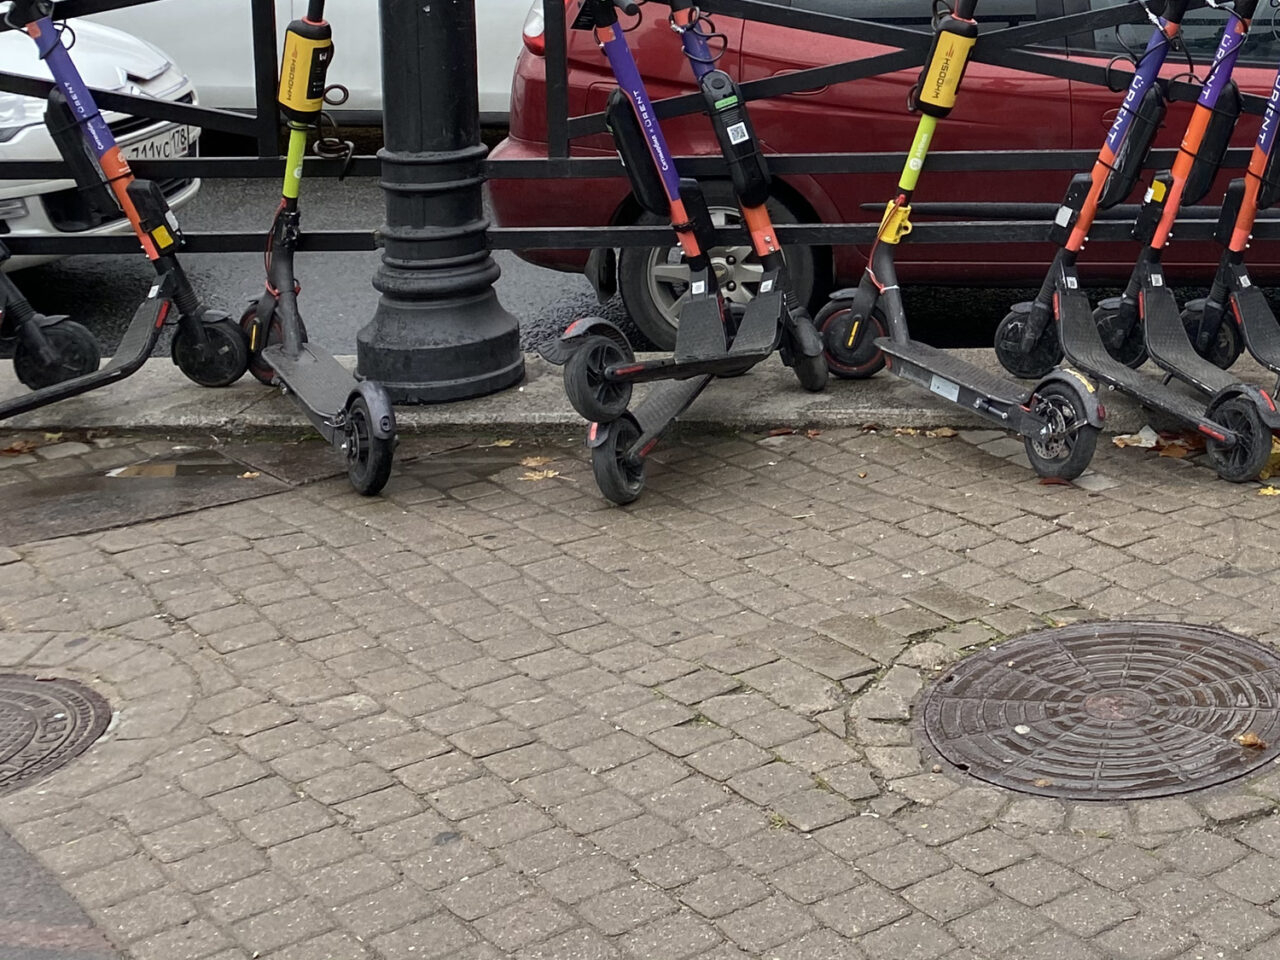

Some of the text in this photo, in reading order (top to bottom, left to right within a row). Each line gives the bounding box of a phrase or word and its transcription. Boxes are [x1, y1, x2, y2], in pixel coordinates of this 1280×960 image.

[287, 58, 297, 101] WHOOSH
[932, 58, 951, 99] WHOOSH
[171, 128, 187, 148] 178
